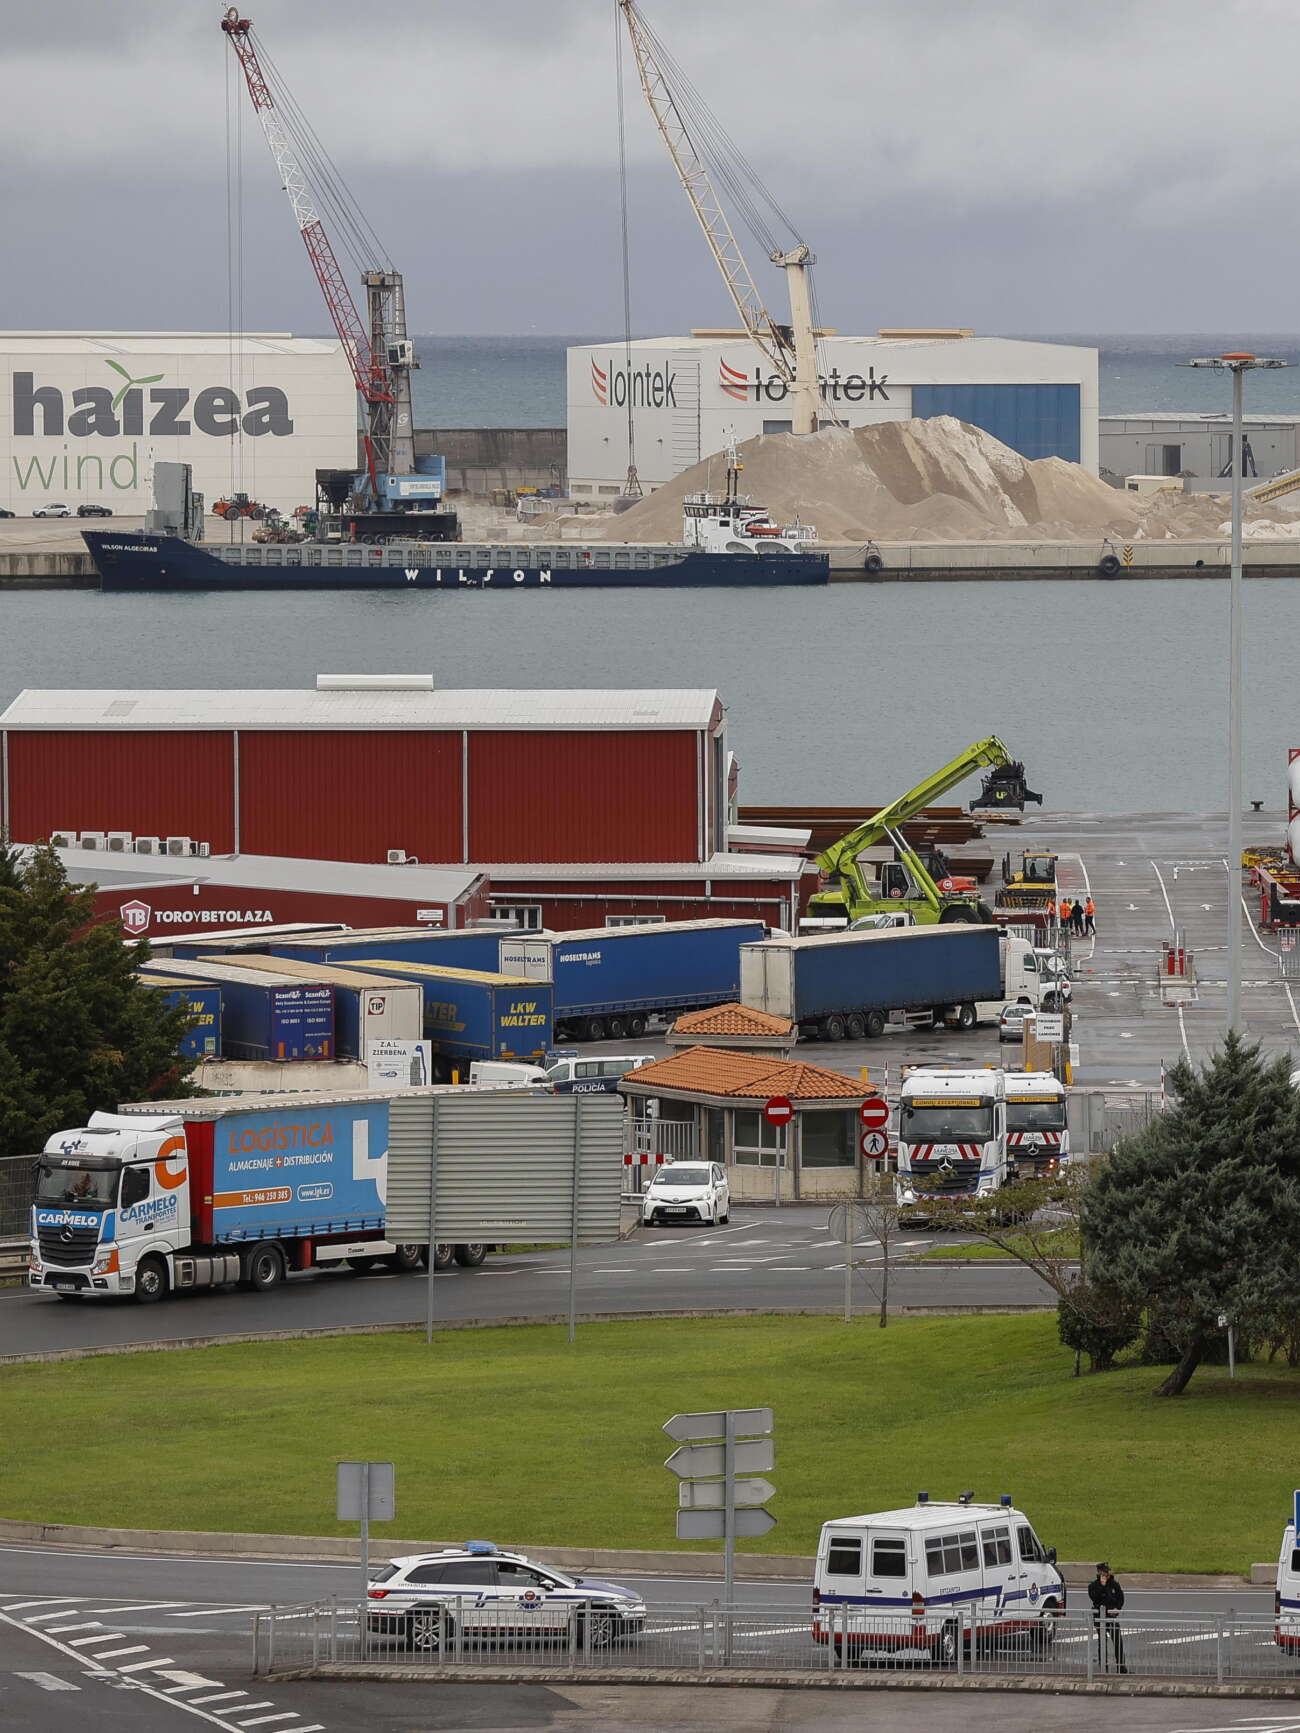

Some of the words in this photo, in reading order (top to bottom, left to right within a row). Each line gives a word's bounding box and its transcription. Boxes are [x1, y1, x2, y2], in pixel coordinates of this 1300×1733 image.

[608, 359, 678, 409] lointek
[12, 371, 294, 437] haizea
[12, 442, 138, 490] wind
[404, 569, 551, 582] WILSON
[371, 1002, 383, 1011] TIP
[510, 1002, 537, 1014] LKW
[500, 1014, 546, 1027] WALTER
[228, 1120, 335, 1154] LOGÍSTICA
[228, 1157, 274, 1172] ALMACENAJE
[283, 1151, 334, 1167] DISTRIBUCIÓN
[119, 1194, 178, 1223] CARMELO
[38, 1213, 98, 1226] CARMELO
